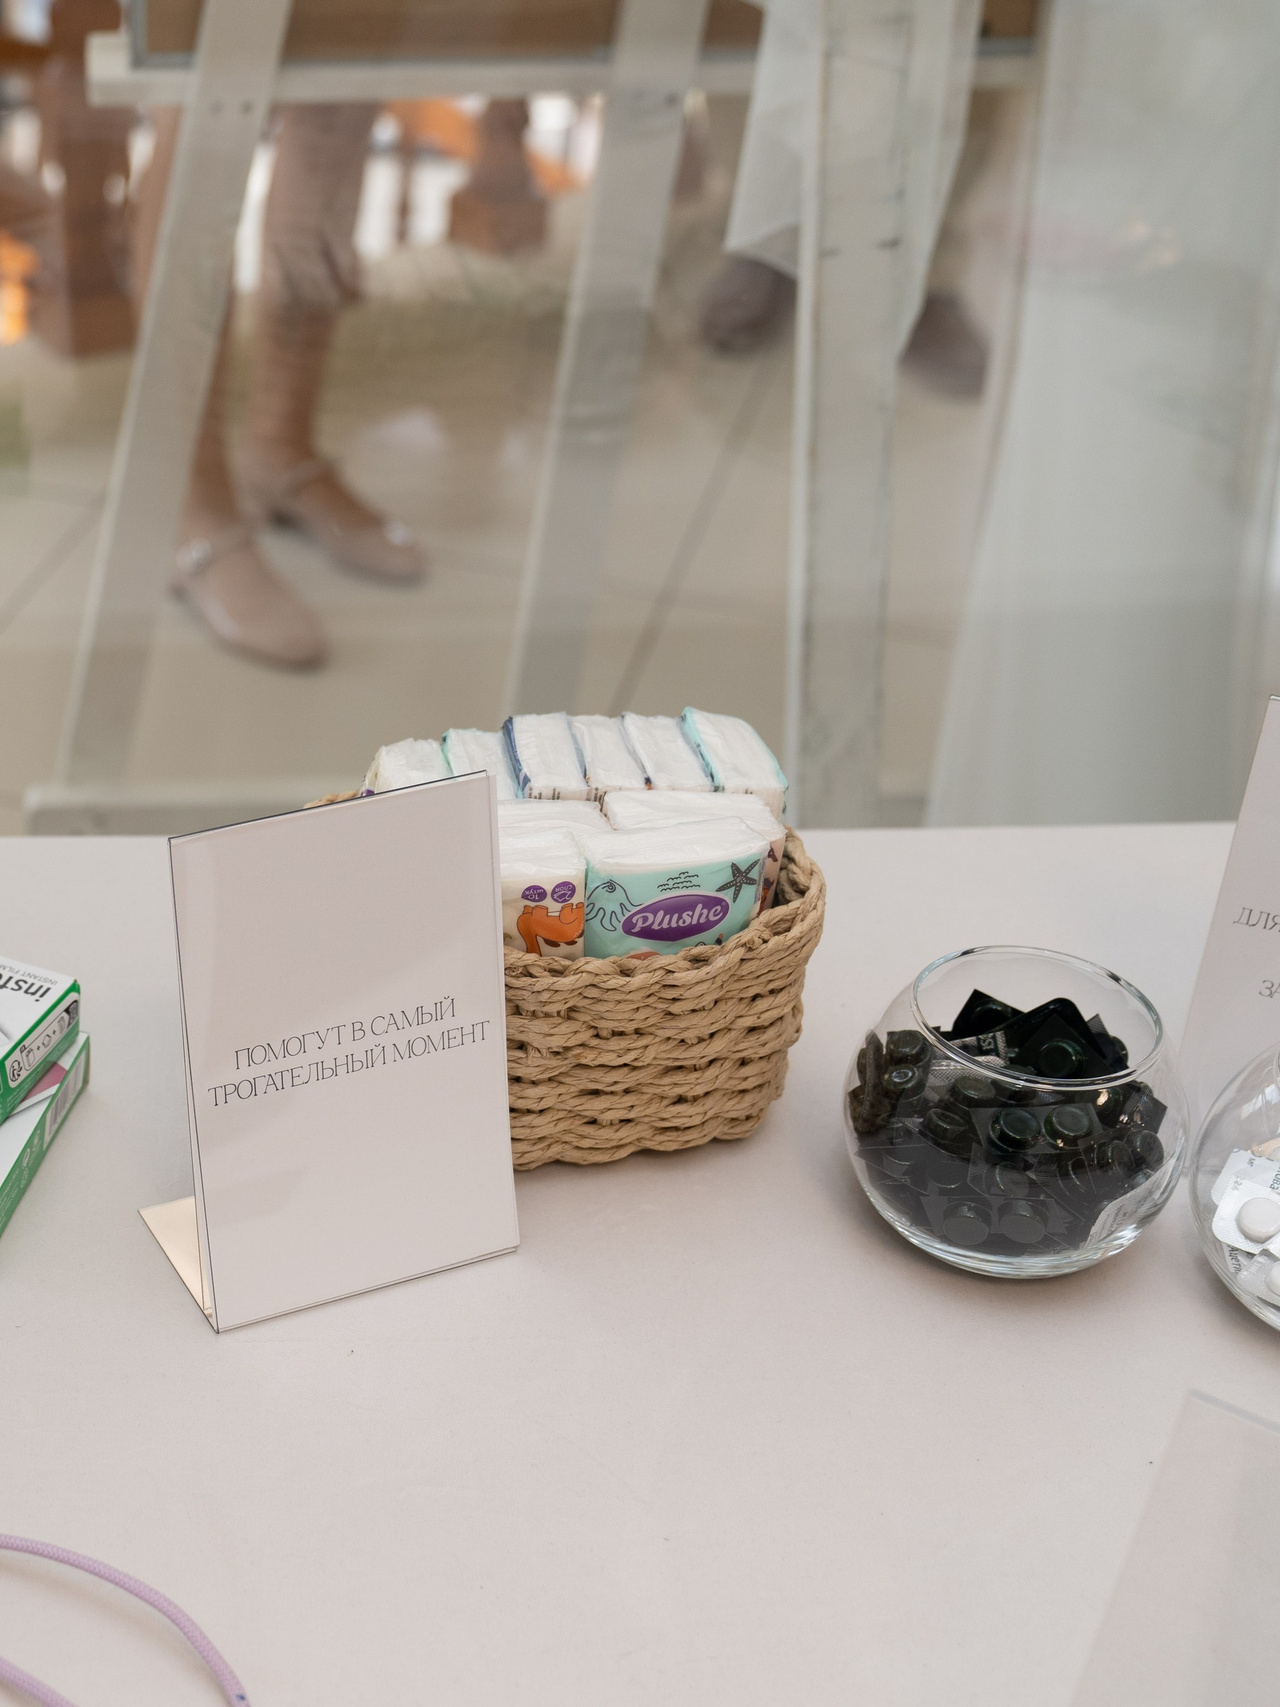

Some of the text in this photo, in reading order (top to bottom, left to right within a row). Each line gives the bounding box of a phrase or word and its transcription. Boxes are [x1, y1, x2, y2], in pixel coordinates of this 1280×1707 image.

[631, 902, 723, 933] Plushe
[207, 1020, 491, 1107] ТРОГАТЕЛЬНЫЙ МОМЕНТ
[234, 995, 456, 1070] ПОМОГУТ В САМЫЙ
